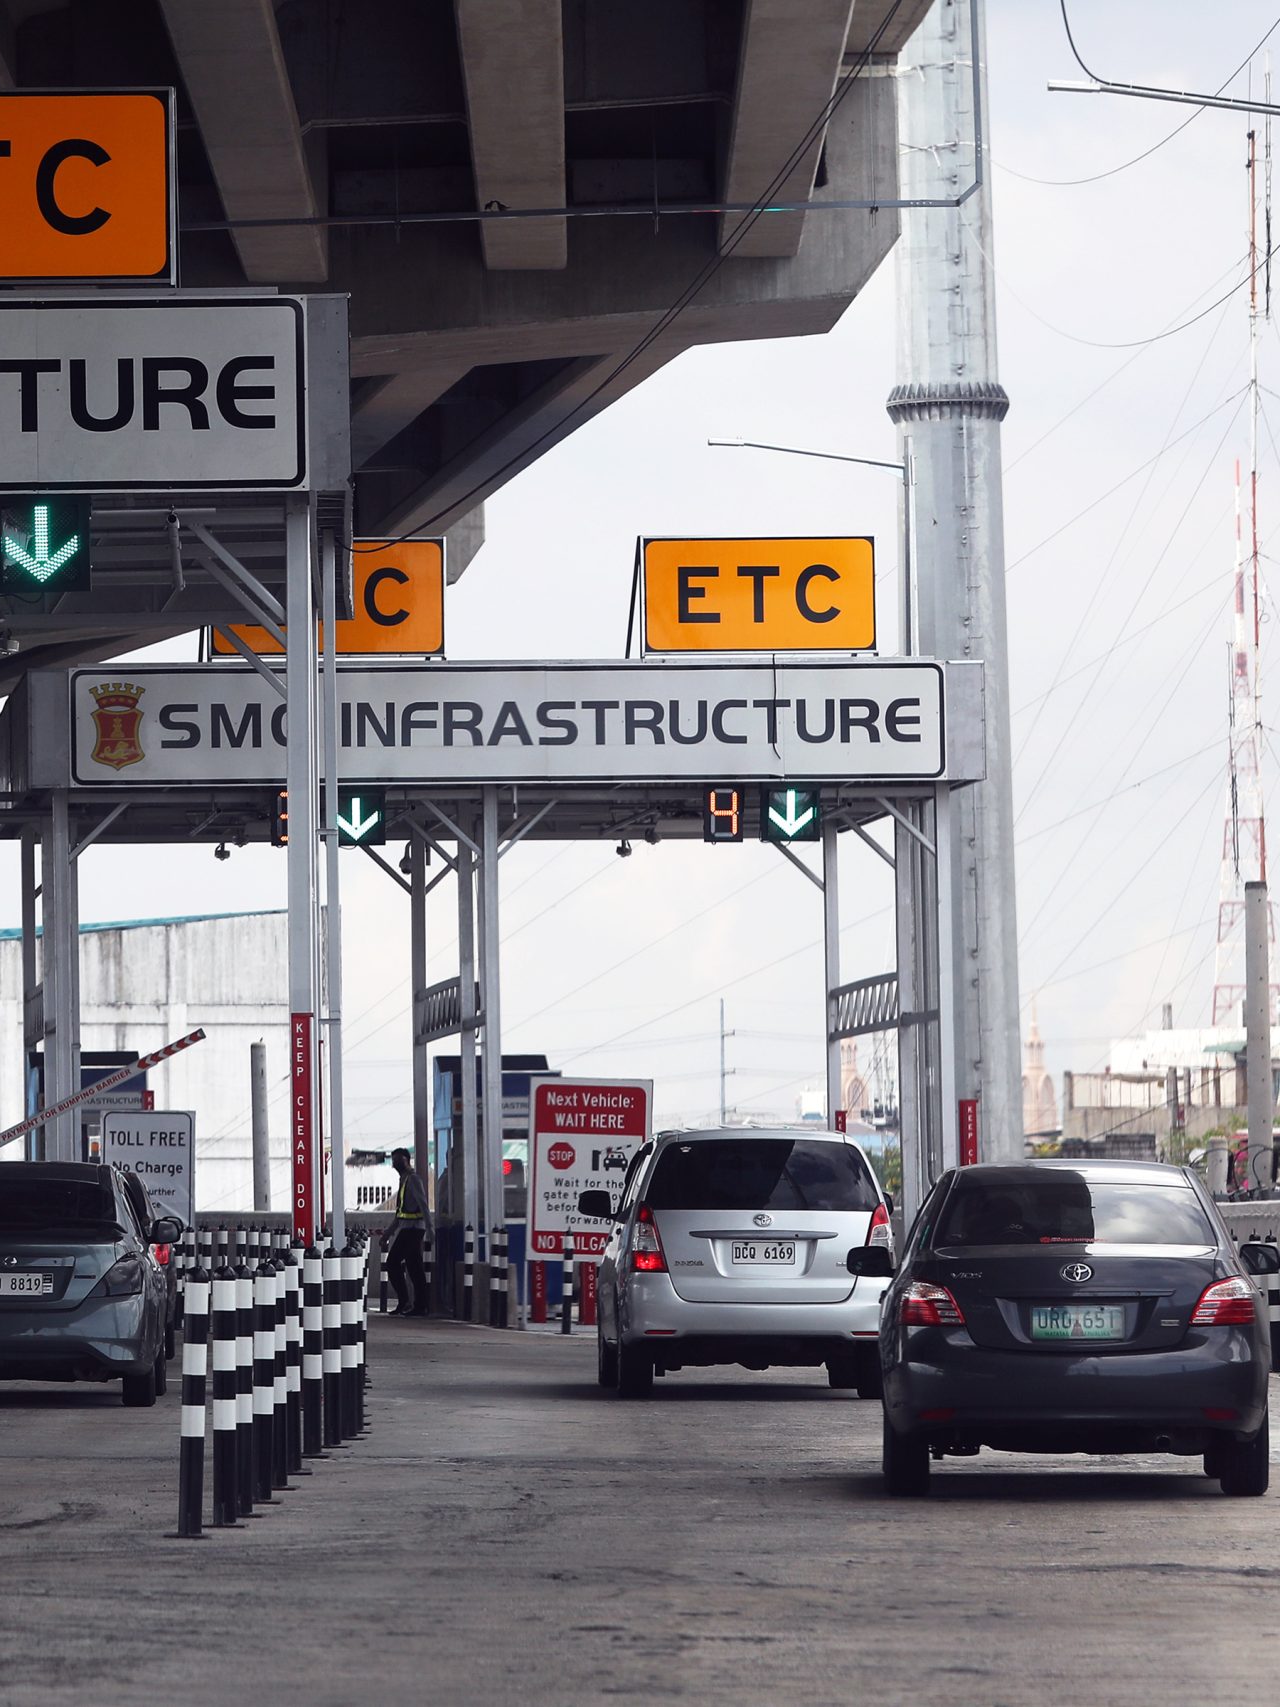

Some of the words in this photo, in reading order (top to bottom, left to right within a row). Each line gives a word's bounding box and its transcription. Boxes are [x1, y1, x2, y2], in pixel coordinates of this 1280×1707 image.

[677, 564, 841, 624] ETC
[341, 697, 921, 748] INFRASTRUCTURE
[709, 790, 738, 837] 4
[296, 1023, 304, 1077] KEEP
[1, 1118, 39, 1141] PAYMENT
[40, 1108, 57, 1123] FOR
[58, 1088, 96, 1112] BUMPING
[96, 1068, 132, 1091] BARRIER
[546, 1091, 578, 1107] Next
[582, 1092, 635, 1109] Vehicle:
[555, 1113, 586, 1128] WAIT
[590, 1113, 625, 1129] HERE
[297, 1096, 305, 1165] CLEAR
[109, 1131, 144, 1146] TOLL
[150, 1131, 186, 1147] FREE
[549, 1150, 574, 1162] STOP
[135, 1161, 183, 1177] Charge
[554, 1177, 579, 1188] Wait
[585, 1178, 602, 1188] for
[606, 1178, 624, 1189] the
[147, 1188, 176, 1197] urther
[297, 1184, 305, 1209] DO
[543, 1191, 569, 1202] gate
[547, 1201, 577, 1212] befor
[537, 1235, 556, 1249] NO
[735, 1247, 756, 1260] DCQ
[764, 1247, 793, 1260] 6169
[10, 1278, 41, 1291] 8819
[1083, 1310, 1115, 1329] 651
